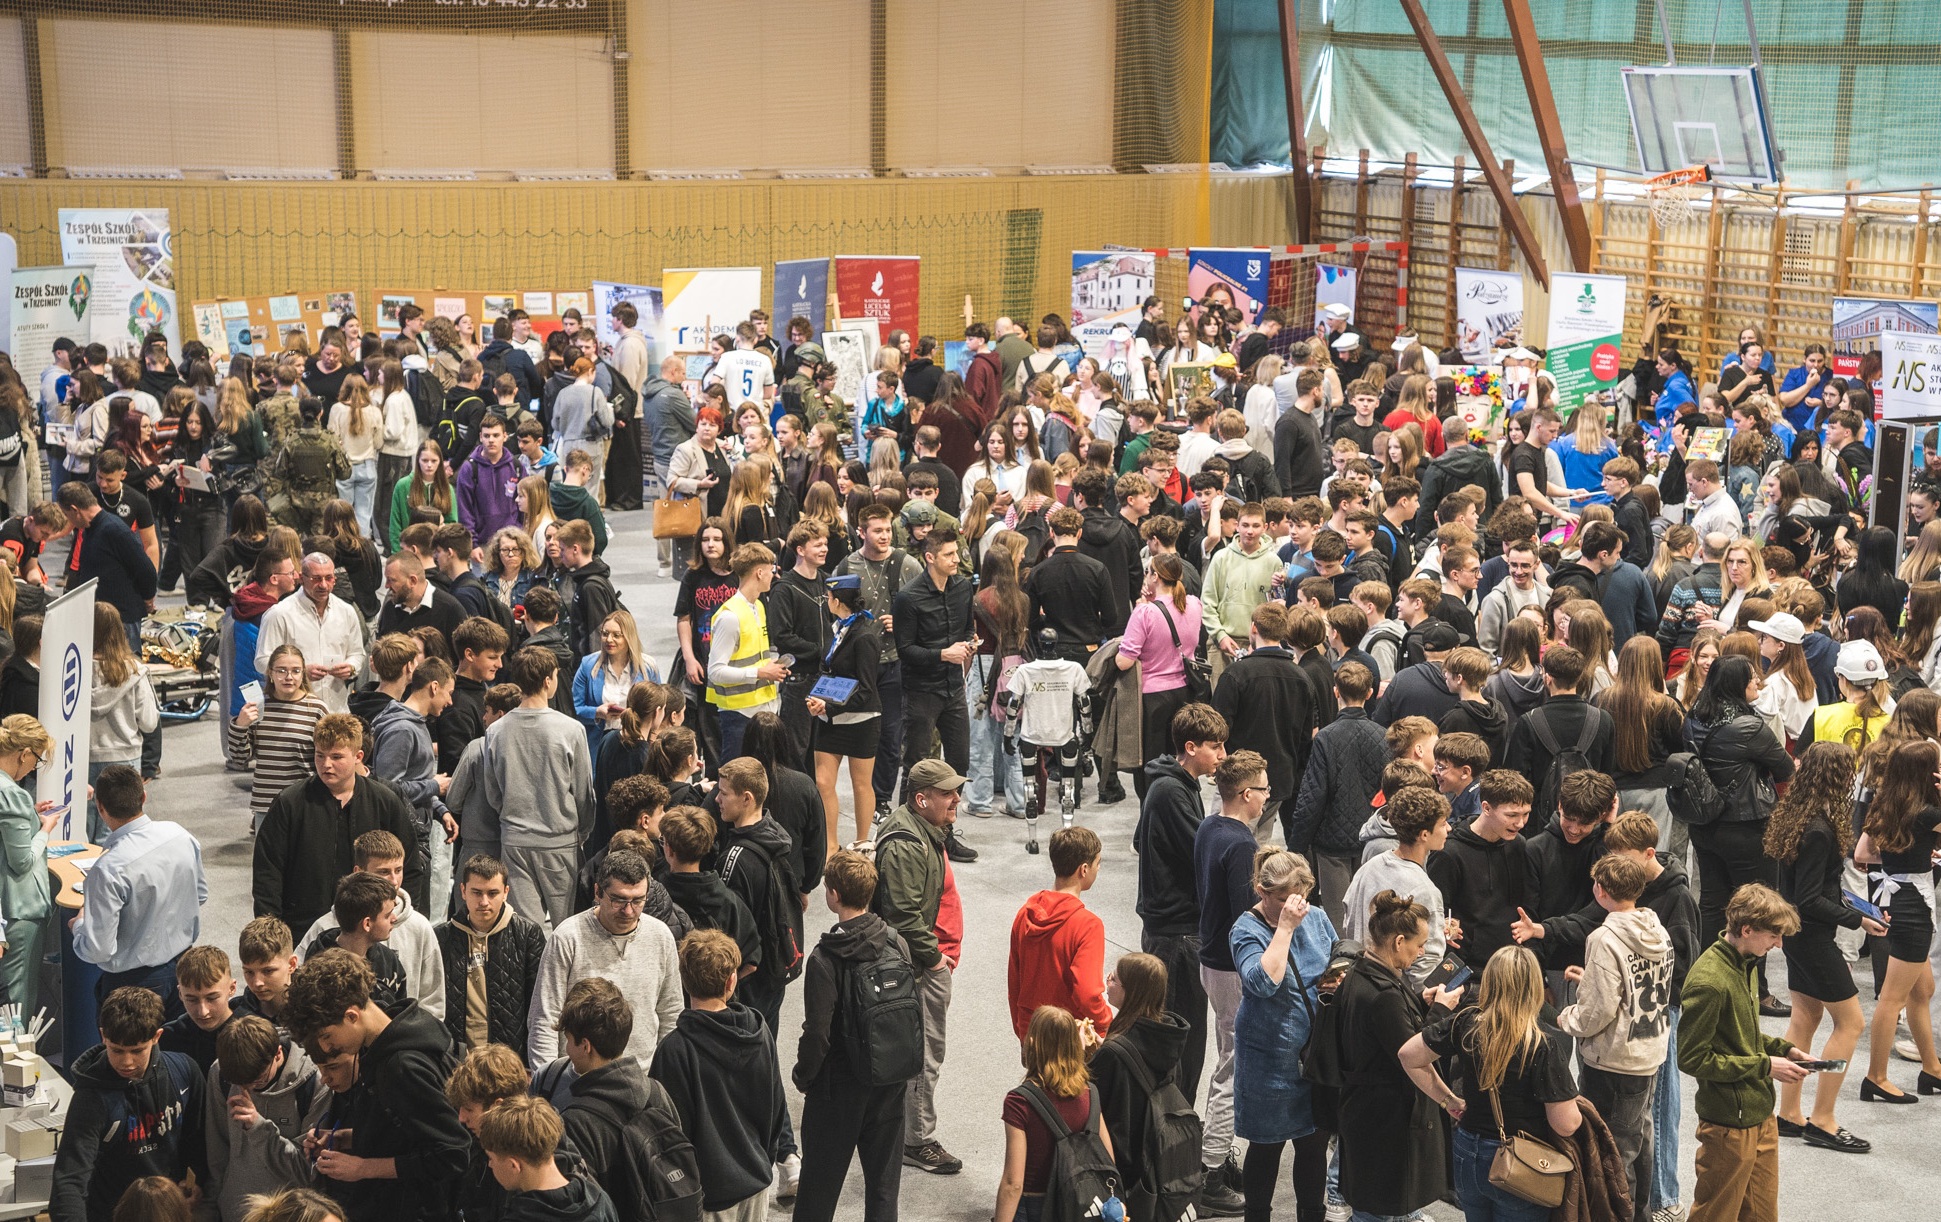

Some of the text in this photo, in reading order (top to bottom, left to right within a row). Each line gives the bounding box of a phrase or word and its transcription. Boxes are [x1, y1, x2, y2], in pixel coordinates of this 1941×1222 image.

[15, 283, 69, 299] ZESPÓŁ SZKÓŁ
[29, 298, 62, 309] TRZCINICY
[742, 369, 753, 397] 5
